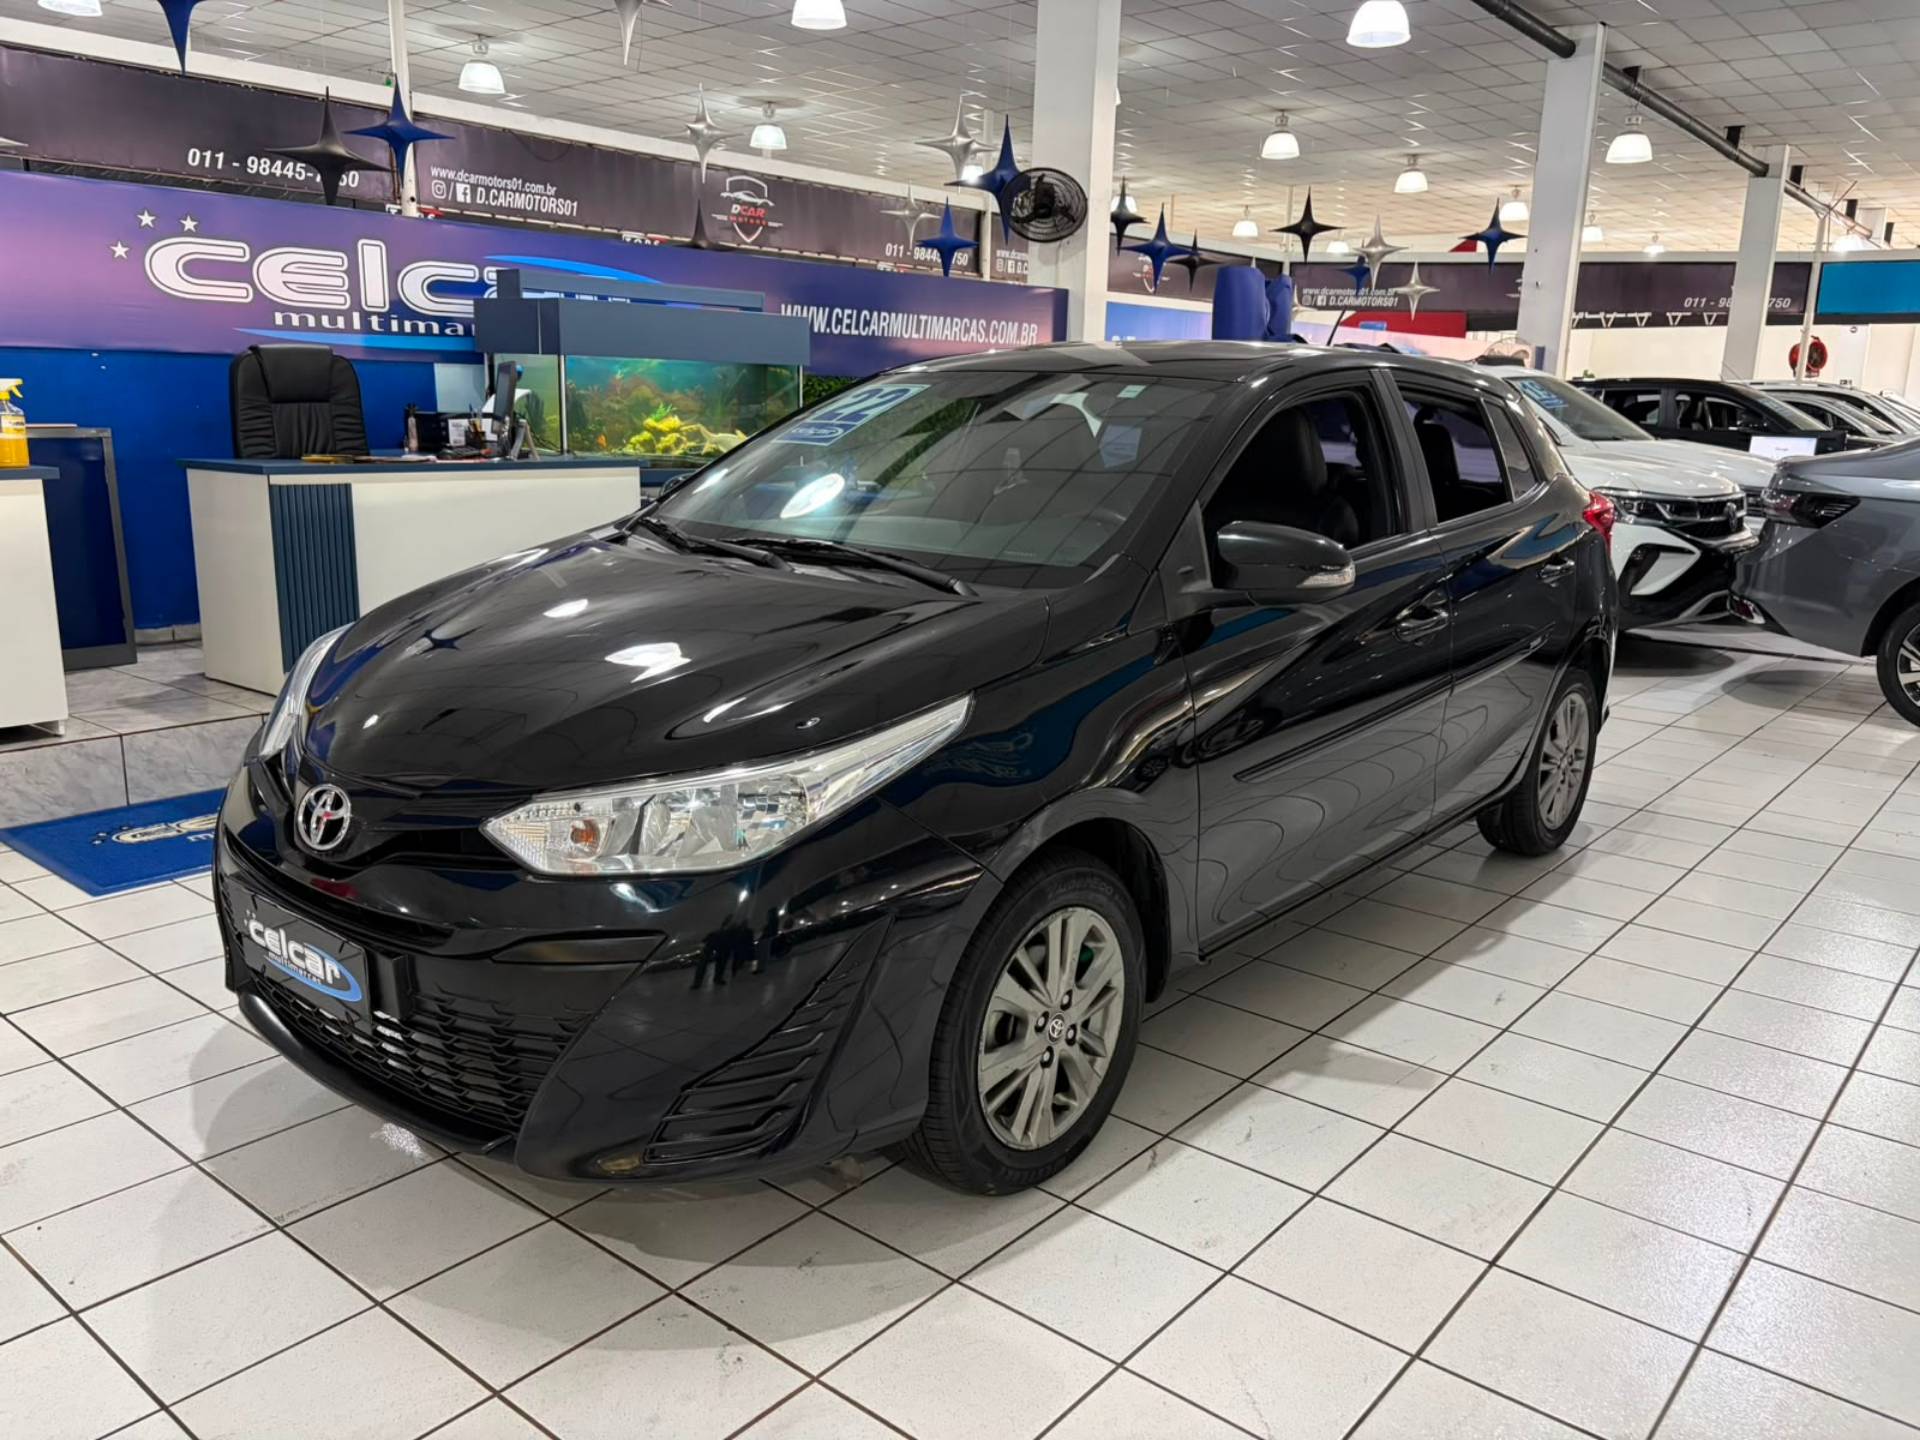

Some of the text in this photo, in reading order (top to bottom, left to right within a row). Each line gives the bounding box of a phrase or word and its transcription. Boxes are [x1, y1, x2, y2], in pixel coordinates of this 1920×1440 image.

[187, 147, 225, 170] 011
[430, 165, 557, 196] www.dcarmotors01.com.br
[476, 188, 579, 217] D.CARMOTORS01
[731, 203, 767, 218] DCAR
[885, 243, 904, 258] 011
[1684, 297, 1707, 308] 011
[249, 919, 341, 985] celcar
